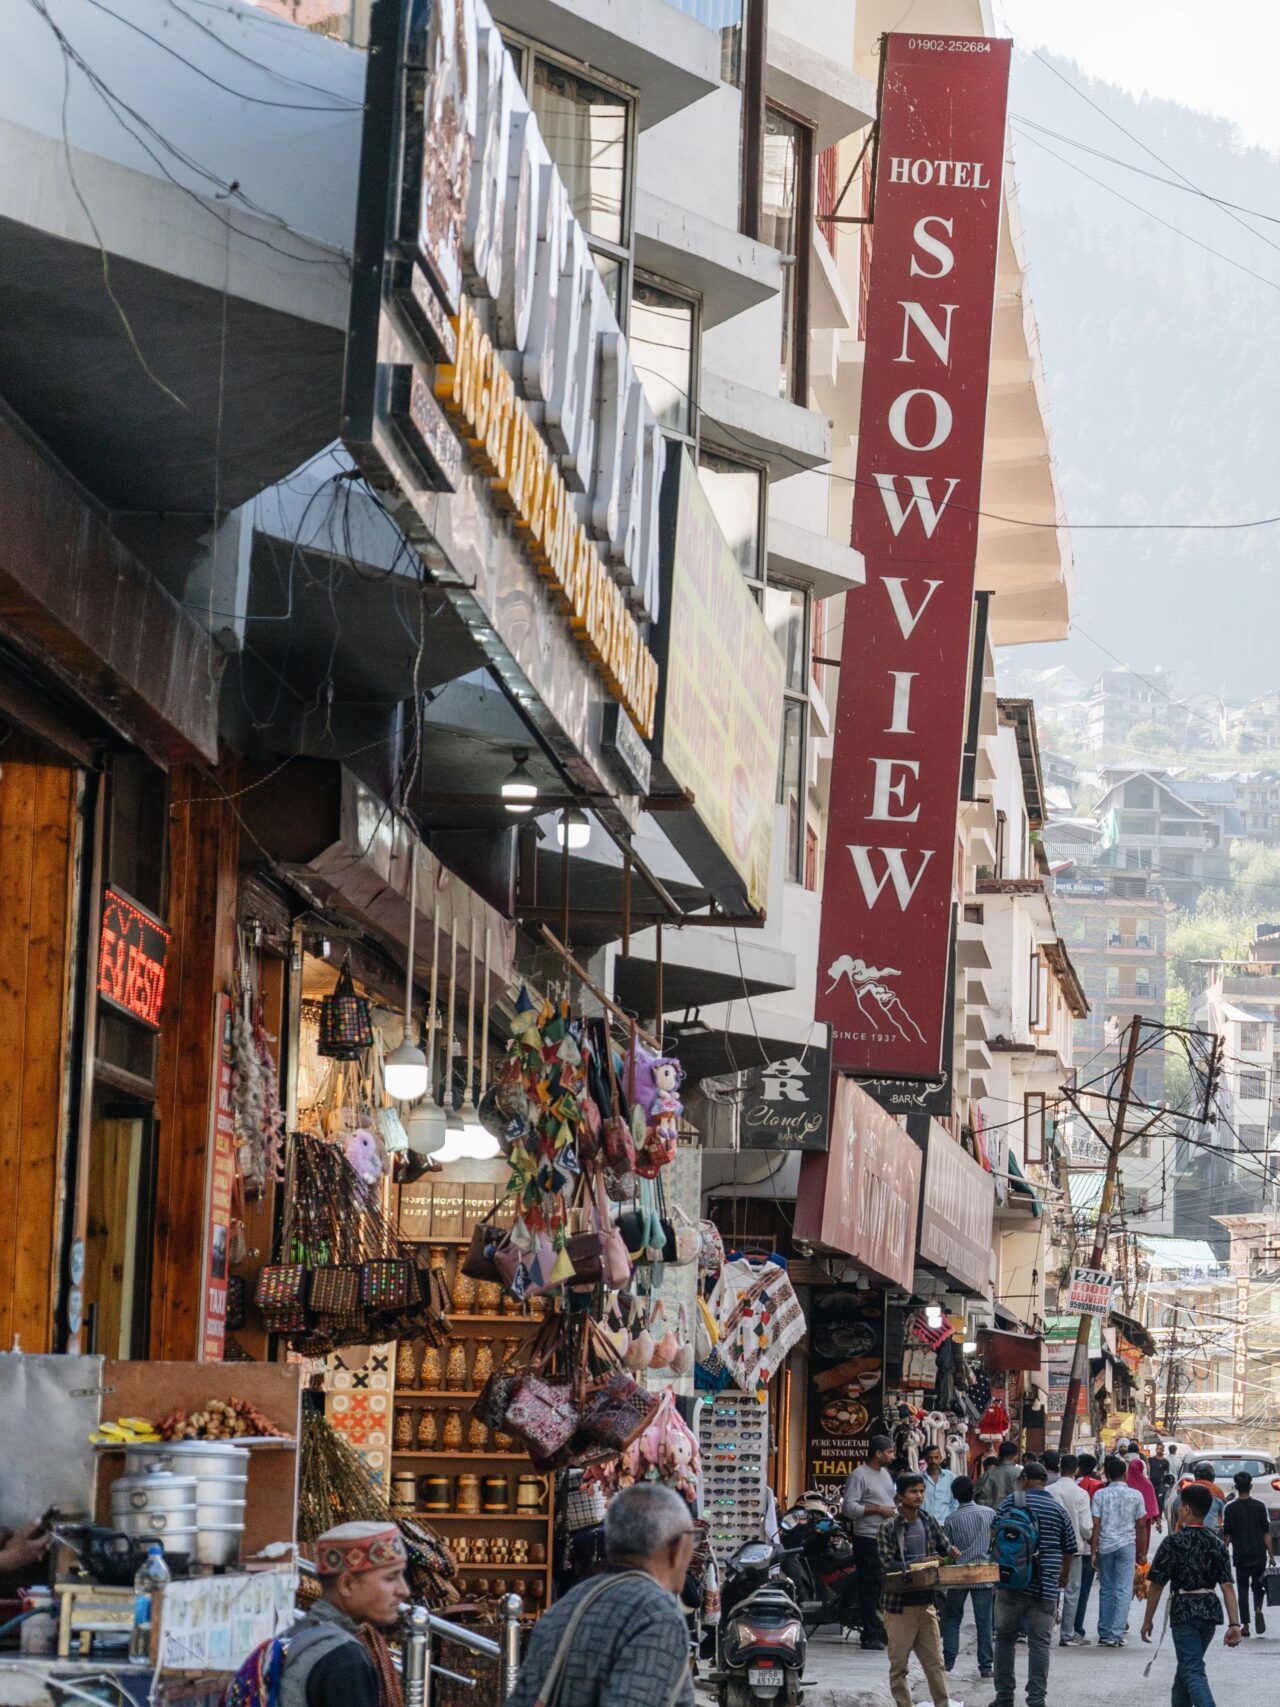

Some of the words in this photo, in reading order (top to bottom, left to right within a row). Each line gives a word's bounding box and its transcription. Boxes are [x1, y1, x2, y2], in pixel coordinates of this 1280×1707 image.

[908, 38, 991, 53] 01902-252684
[888, 156, 990, 190] HOTEL
[872, 216, 961, 539] SNOW
[607, 331, 667, 625] YAK
[453, 293, 515, 479] NIGHT
[507, 393, 548, 542] LIFE
[586, 541, 659, 741] RESTAURANT
[845, 578, 943, 912] VIEW
[832, 1030, 867, 1041] SINCE
[871, 1033, 897, 1043] 1937
[746, 1104, 806, 1128] Cloud
[433, 1196, 464, 1206] MONEY
[1075, 1270, 1112, 1286] 24/7
[1072, 1282, 1110, 1296] FOOD
[1070, 1290, 1109, 1306] DELIVERY
[811, 1439, 831, 1447] PURE
[833, 1439, 870, 1447] VEGETARI
